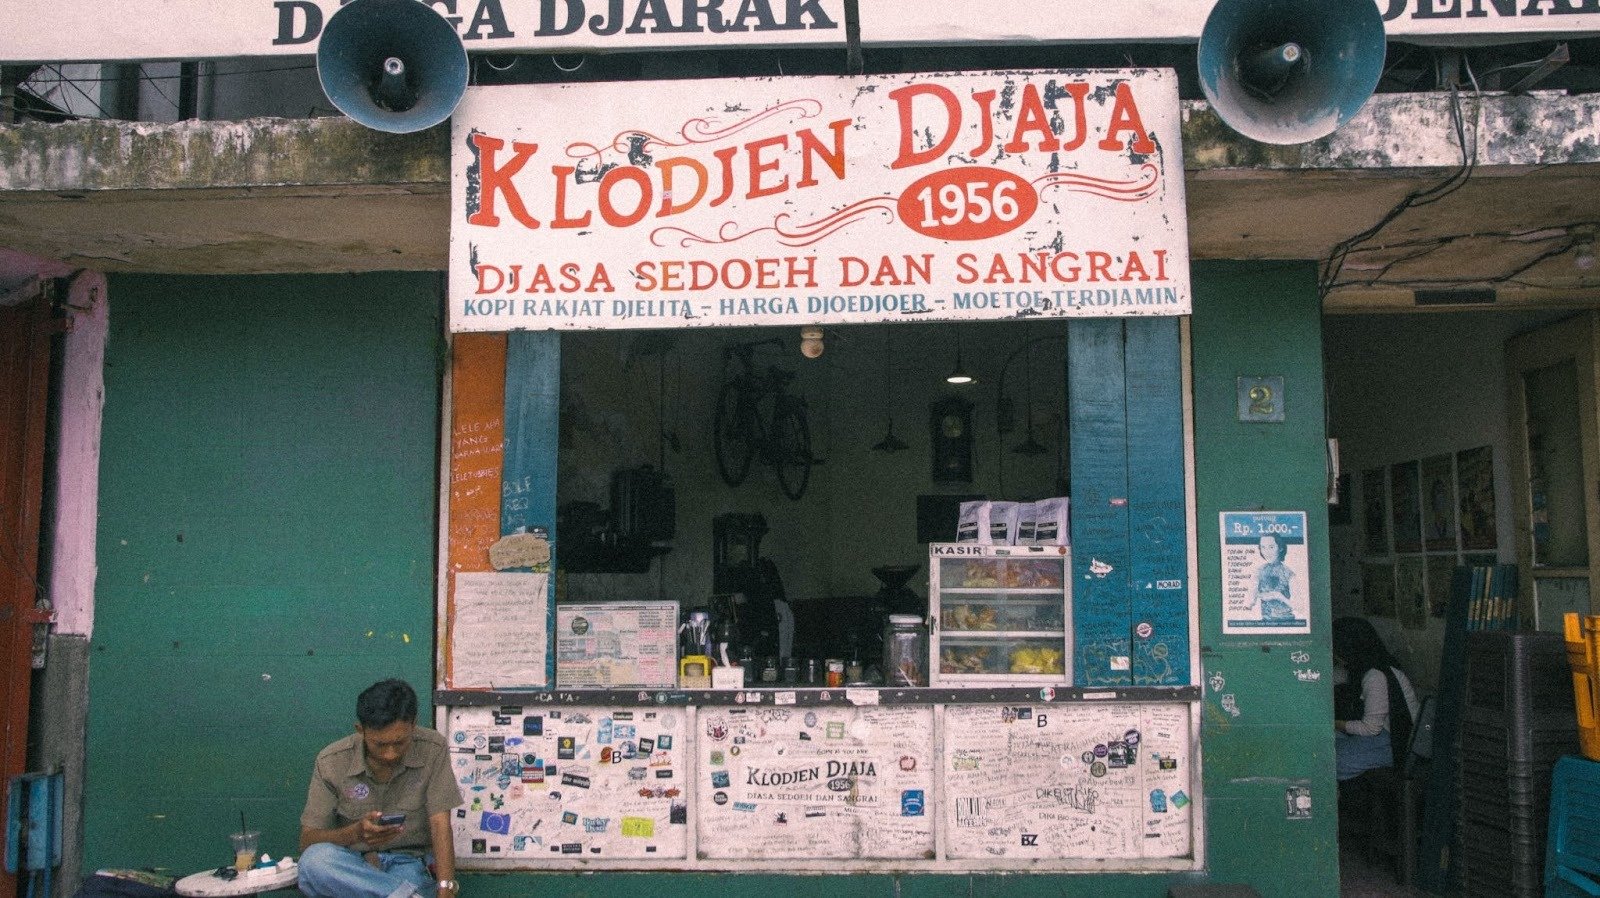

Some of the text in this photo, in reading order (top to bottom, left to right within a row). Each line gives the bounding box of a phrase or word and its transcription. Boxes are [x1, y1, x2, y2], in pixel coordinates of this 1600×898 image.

[535, 0, 838, 37] DJARAK
[468, 82, 1156, 230] KLODJEN DJAJA
[917, 178, 1021, 228] 1956
[476, 249, 1168, 295] DJASA SEDOEH DAN SANGRAI
[463, 299, 515, 316] KOPI
[523, 299, 605, 318] RAKJAT
[612, 299, 692, 319] DJELITA
[719, 297, 799, 315] HARGA
[808, 294, 926, 314] DJOEDJOER
[953, 292, 1044, 310] MOETOE
[1053, 287, 1177, 308] TERDJAMIN
[1249, 385, 1273, 414] 2
[1233, 522, 1299, 536] Rp. 1.000,-
[934, 546, 982, 555] KASIR
[1036, 713, 1048, 728] B
[612, 750, 622, 764] B
[746, 760, 877, 786] KLODJEN DJAJA
[830, 780, 851, 790] 1956
[816, 794, 834, 802] DAN
[1021, 833, 1038, 846] BZ
